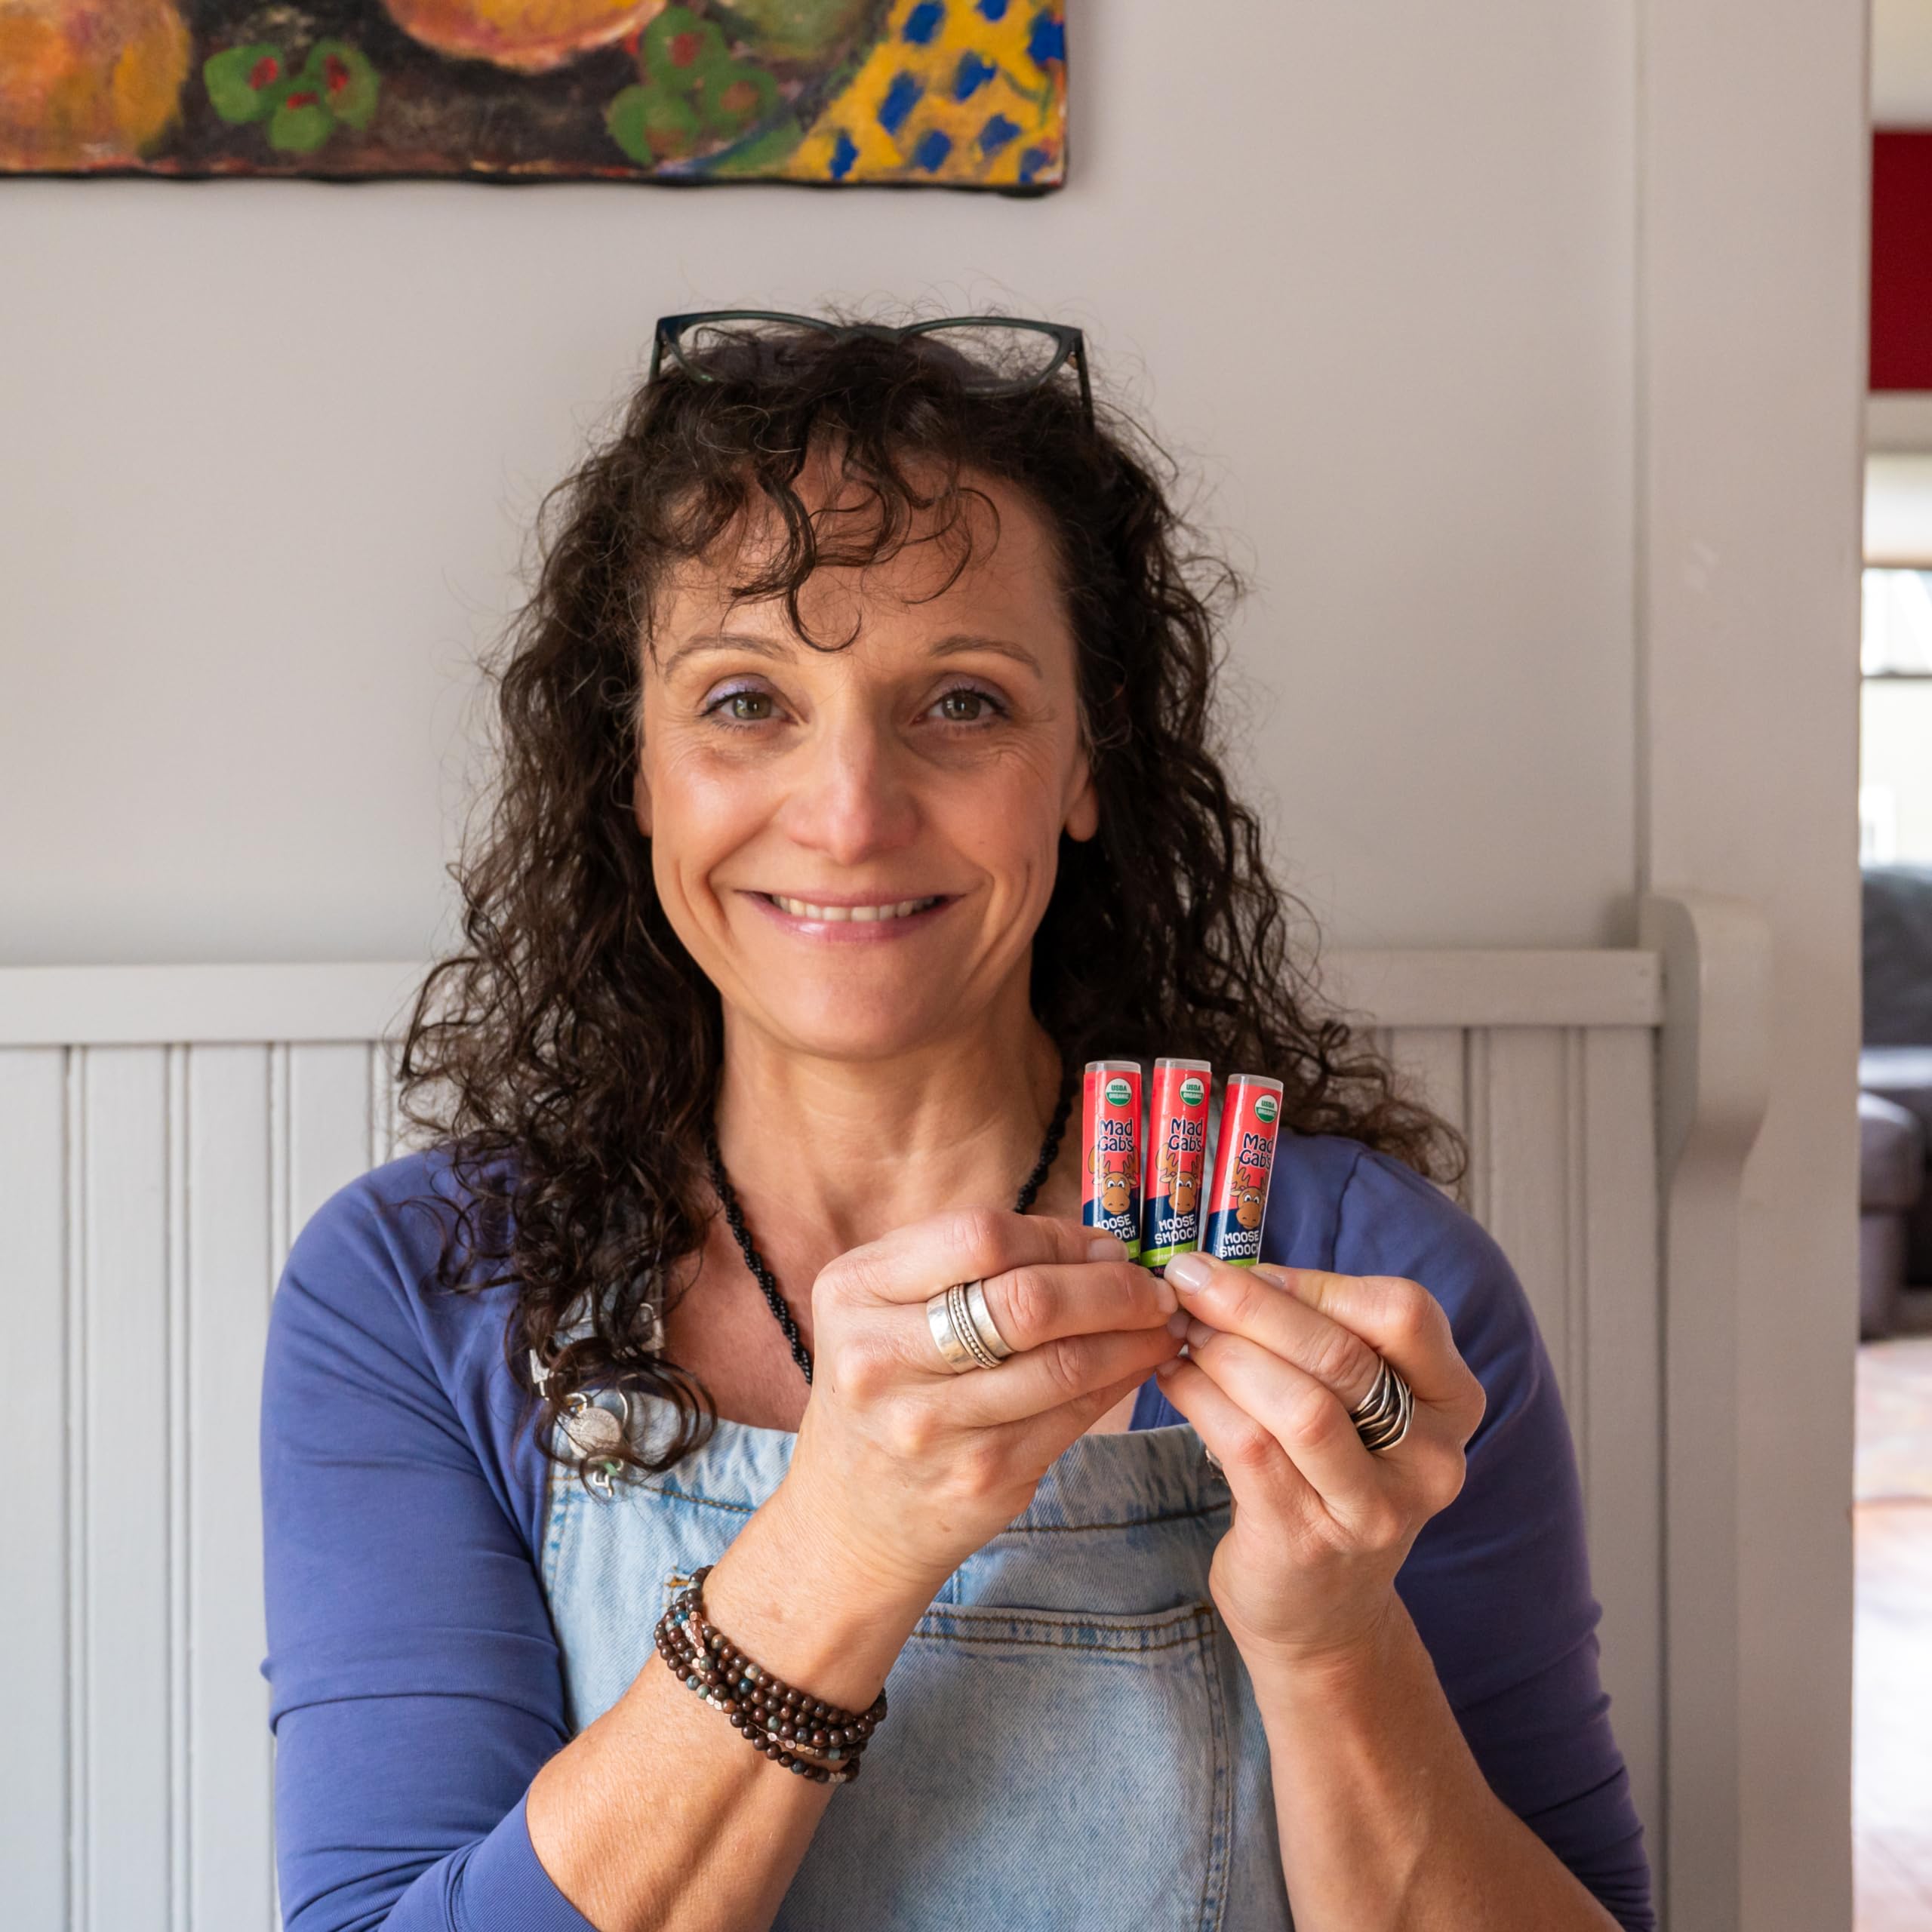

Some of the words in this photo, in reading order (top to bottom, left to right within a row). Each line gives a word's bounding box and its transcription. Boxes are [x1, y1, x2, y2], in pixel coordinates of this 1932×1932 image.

[1099, 1118, 1133, 1137] Mad
[1171, 1118, 1203, 1136] Mad
[1097, 1136, 1134, 1152] Gab's
[1168, 1134, 1202, 1152] Gab's
[1243, 1132, 1275, 1154] Mad
[1239, 1149, 1272, 1169] Gab's
[1158, 1214, 1195, 1232] MOOSE
[1154, 1225, 1198, 1245] SMOOCH
[1224, 1230, 1260, 1244] MOOSE
